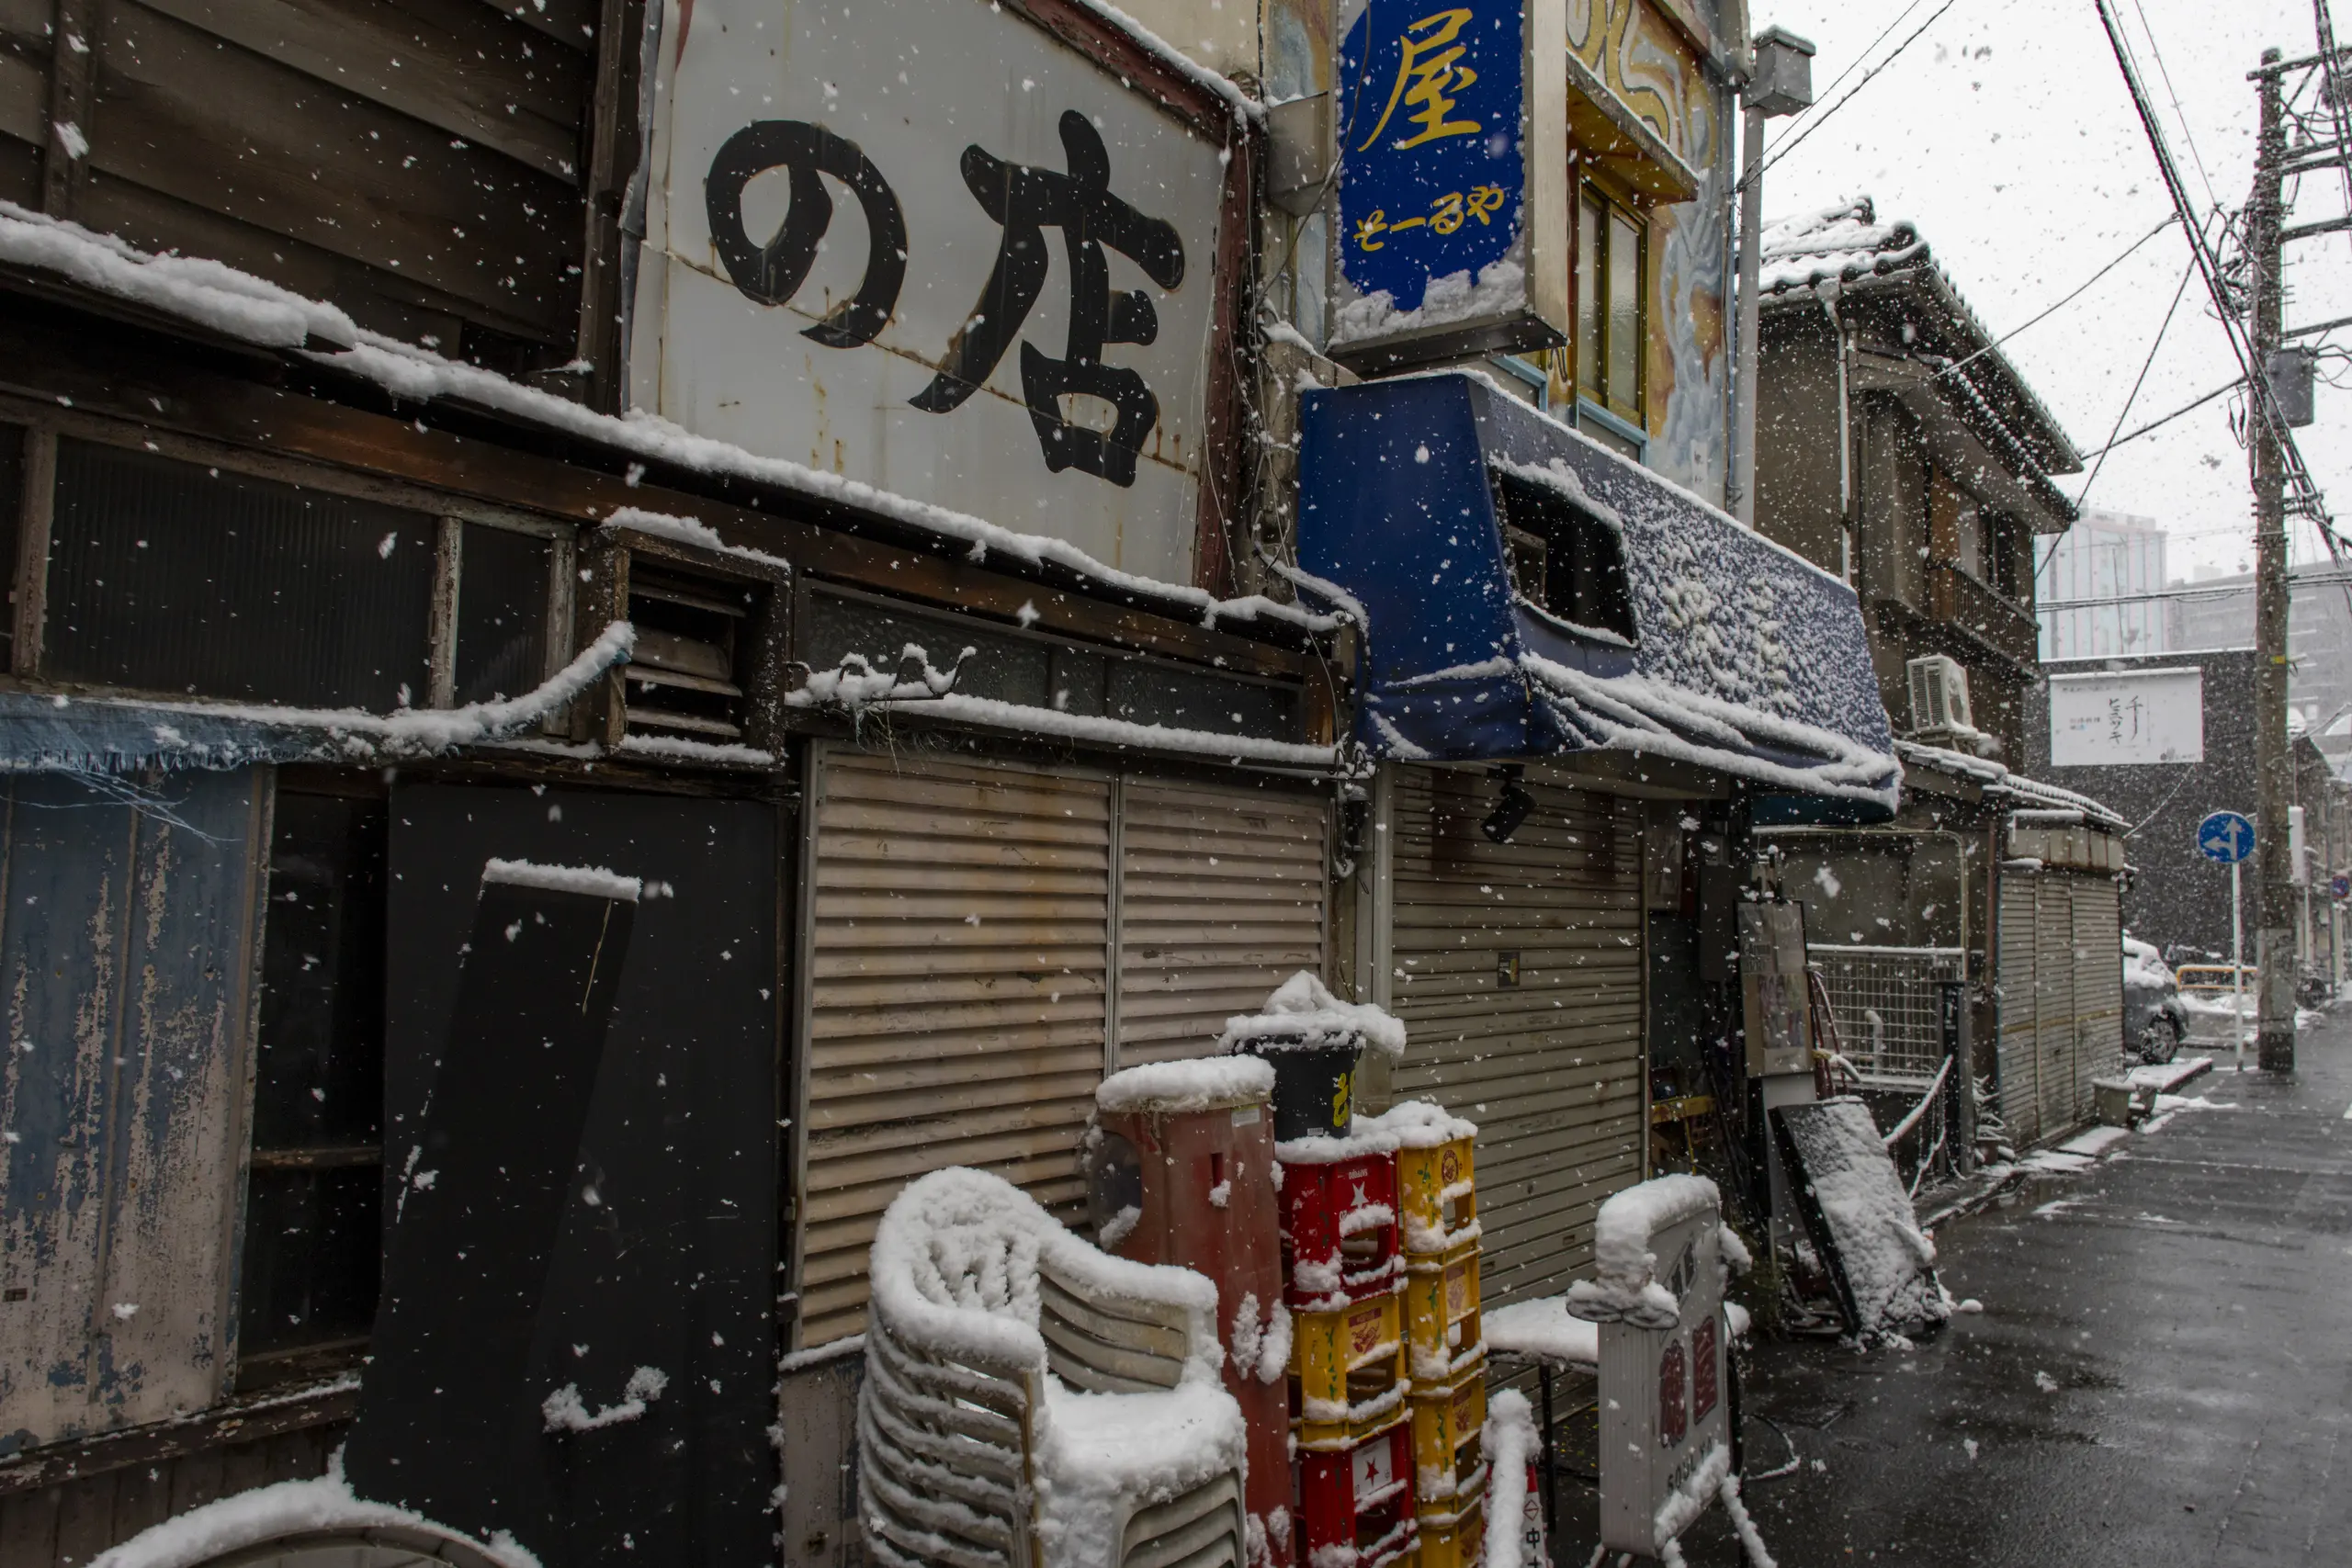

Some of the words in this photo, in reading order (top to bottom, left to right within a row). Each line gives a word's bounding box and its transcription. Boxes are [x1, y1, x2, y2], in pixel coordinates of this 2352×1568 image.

[1357, 7, 1482, 152] 屋
[1353, 186, 1505, 252] そーるや
[706, 109, 1185, 488] の店
